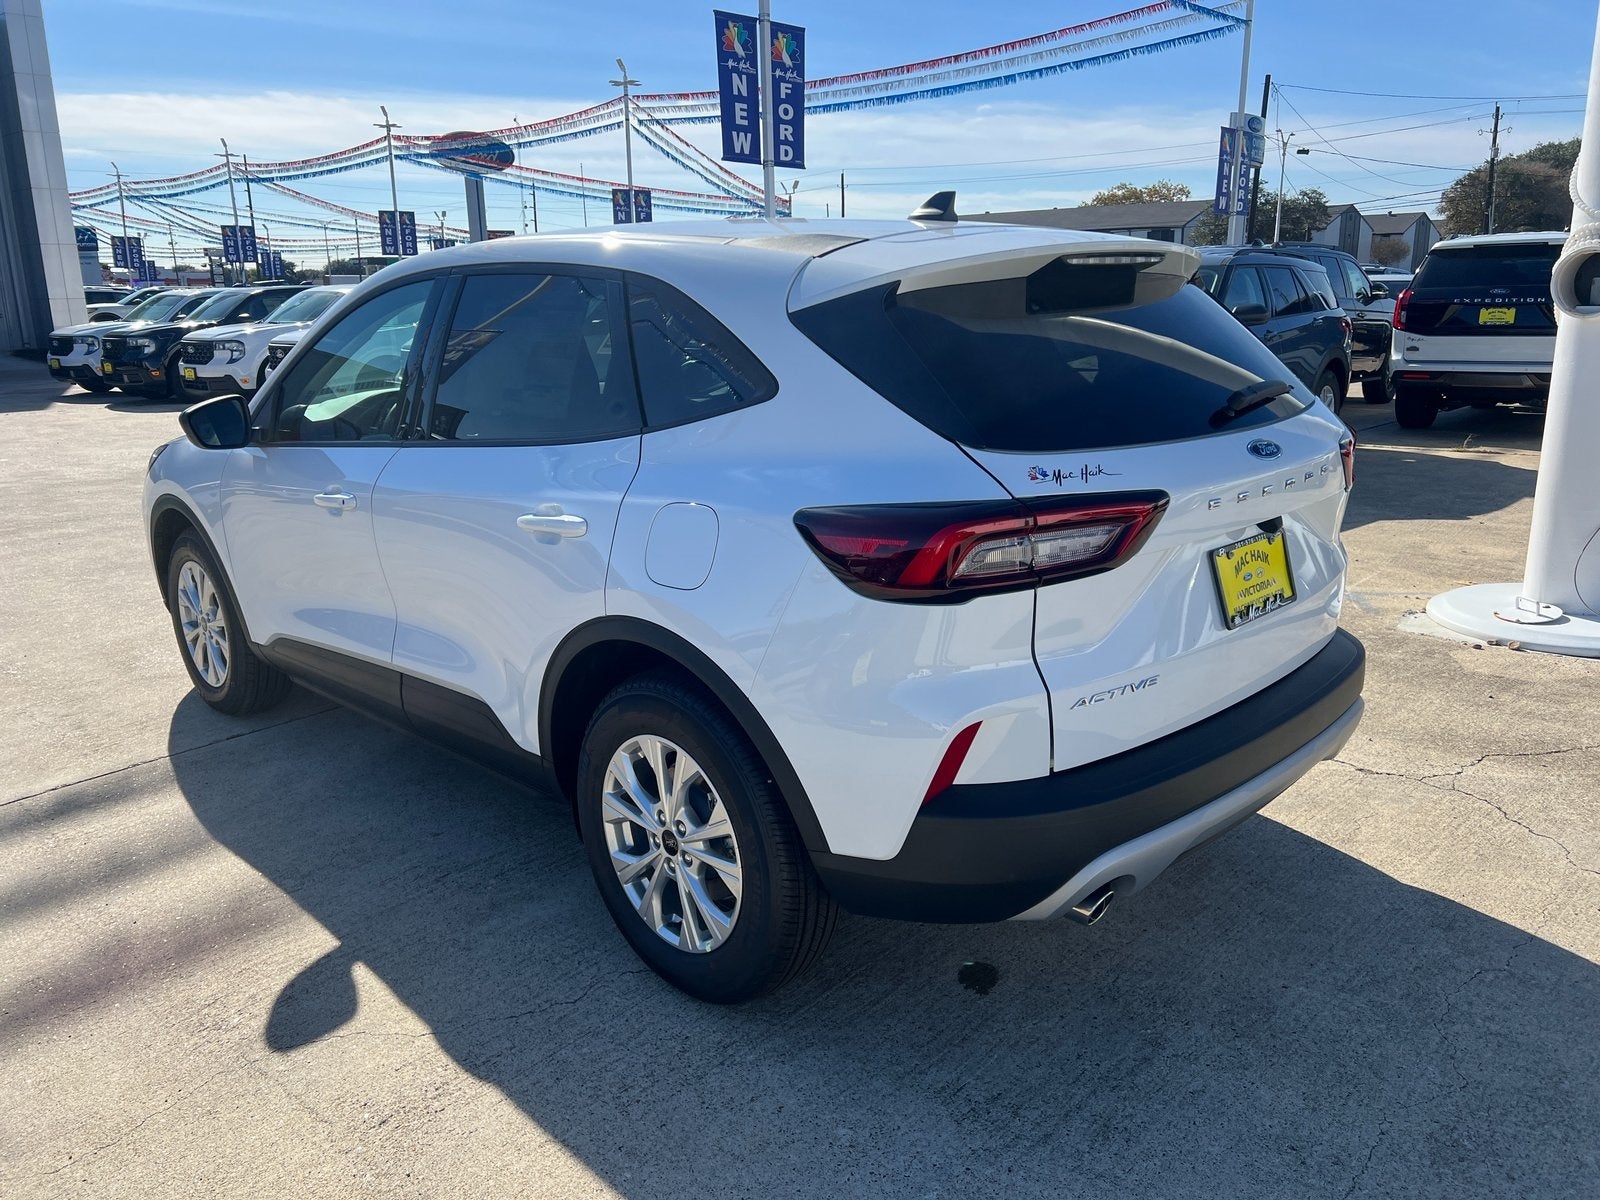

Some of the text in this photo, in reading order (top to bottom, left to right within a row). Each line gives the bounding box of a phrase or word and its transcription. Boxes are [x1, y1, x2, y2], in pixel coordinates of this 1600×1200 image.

[731, 72, 752, 155] NEW
[778, 82, 794, 162] FORD
[1218, 162, 1230, 210] NEW
[1237, 164, 1247, 211] FORD
[227, 240, 237, 261] NEW
[245, 240, 254, 262] FORD
[384, 228, 395, 253] NEW
[405, 228, 414, 254] FORD
[115, 248, 125, 267] NEW
[132, 248, 140, 267] FORD
[1036, 463, 1123, 487] Mac Haik
[1234, 549, 1270, 578] MAC HAIK
[1069, 674, 1160, 710] ACTIVE
